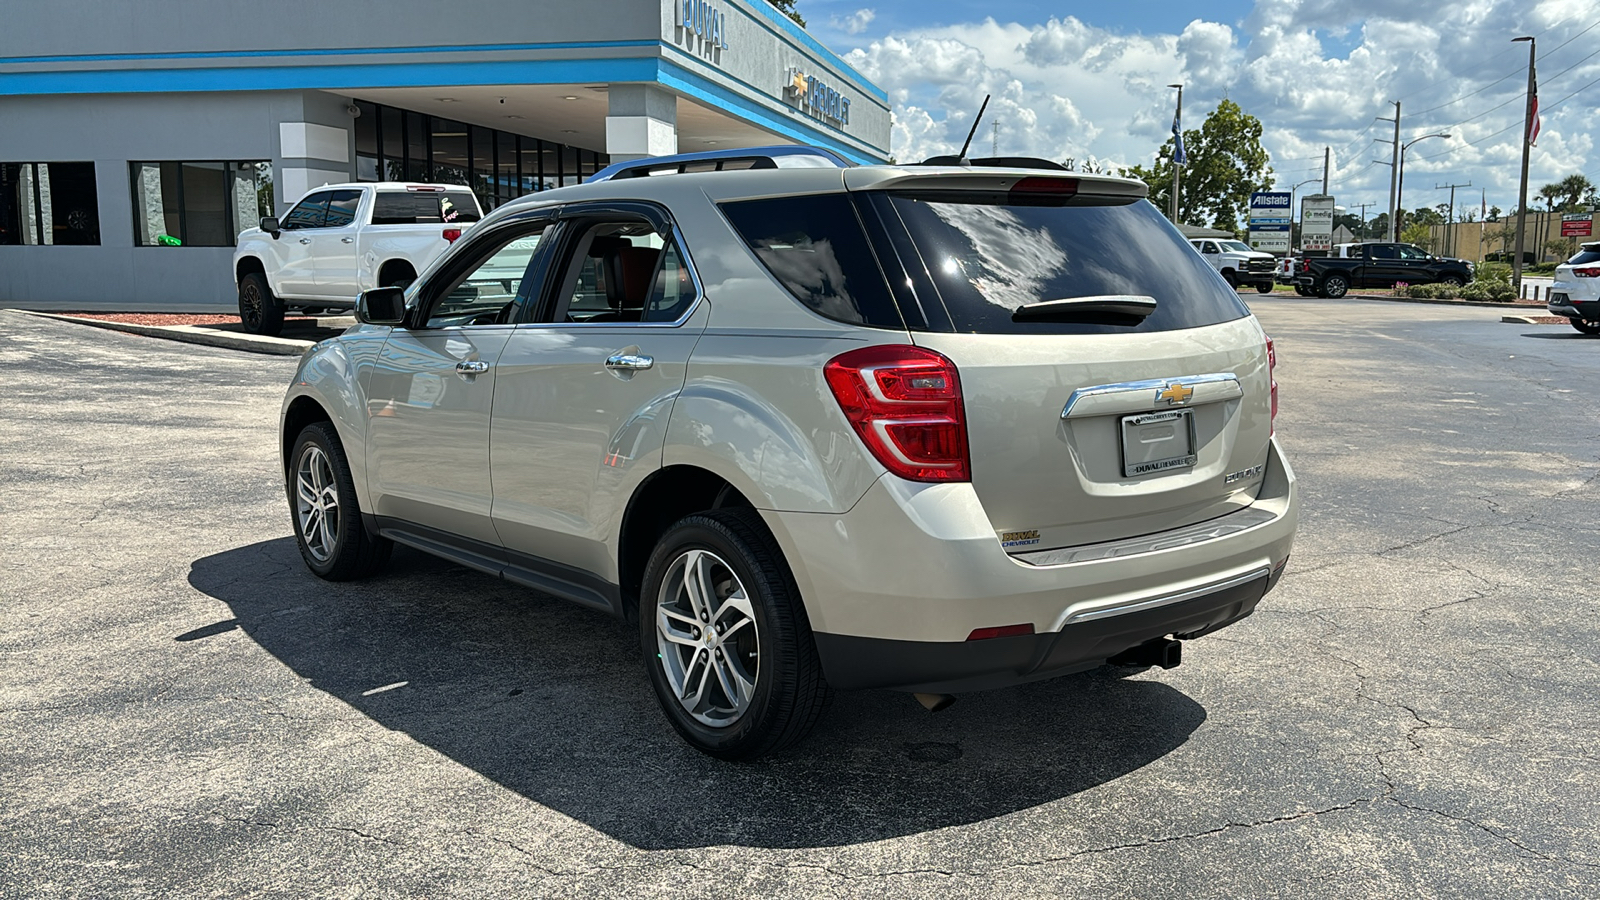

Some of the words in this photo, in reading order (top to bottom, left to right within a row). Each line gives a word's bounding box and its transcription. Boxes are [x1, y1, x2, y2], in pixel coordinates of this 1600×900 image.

[681, 0, 728, 50] DUVAL
[808, 75, 850, 125] CHEVROLET
[1252, 195, 1288, 205] Allstate
[1136, 463, 1160, 473] DUVAL
[1002, 530, 1040, 541] DUVAL
[1002, 539, 1040, 547] CHEVROLET
